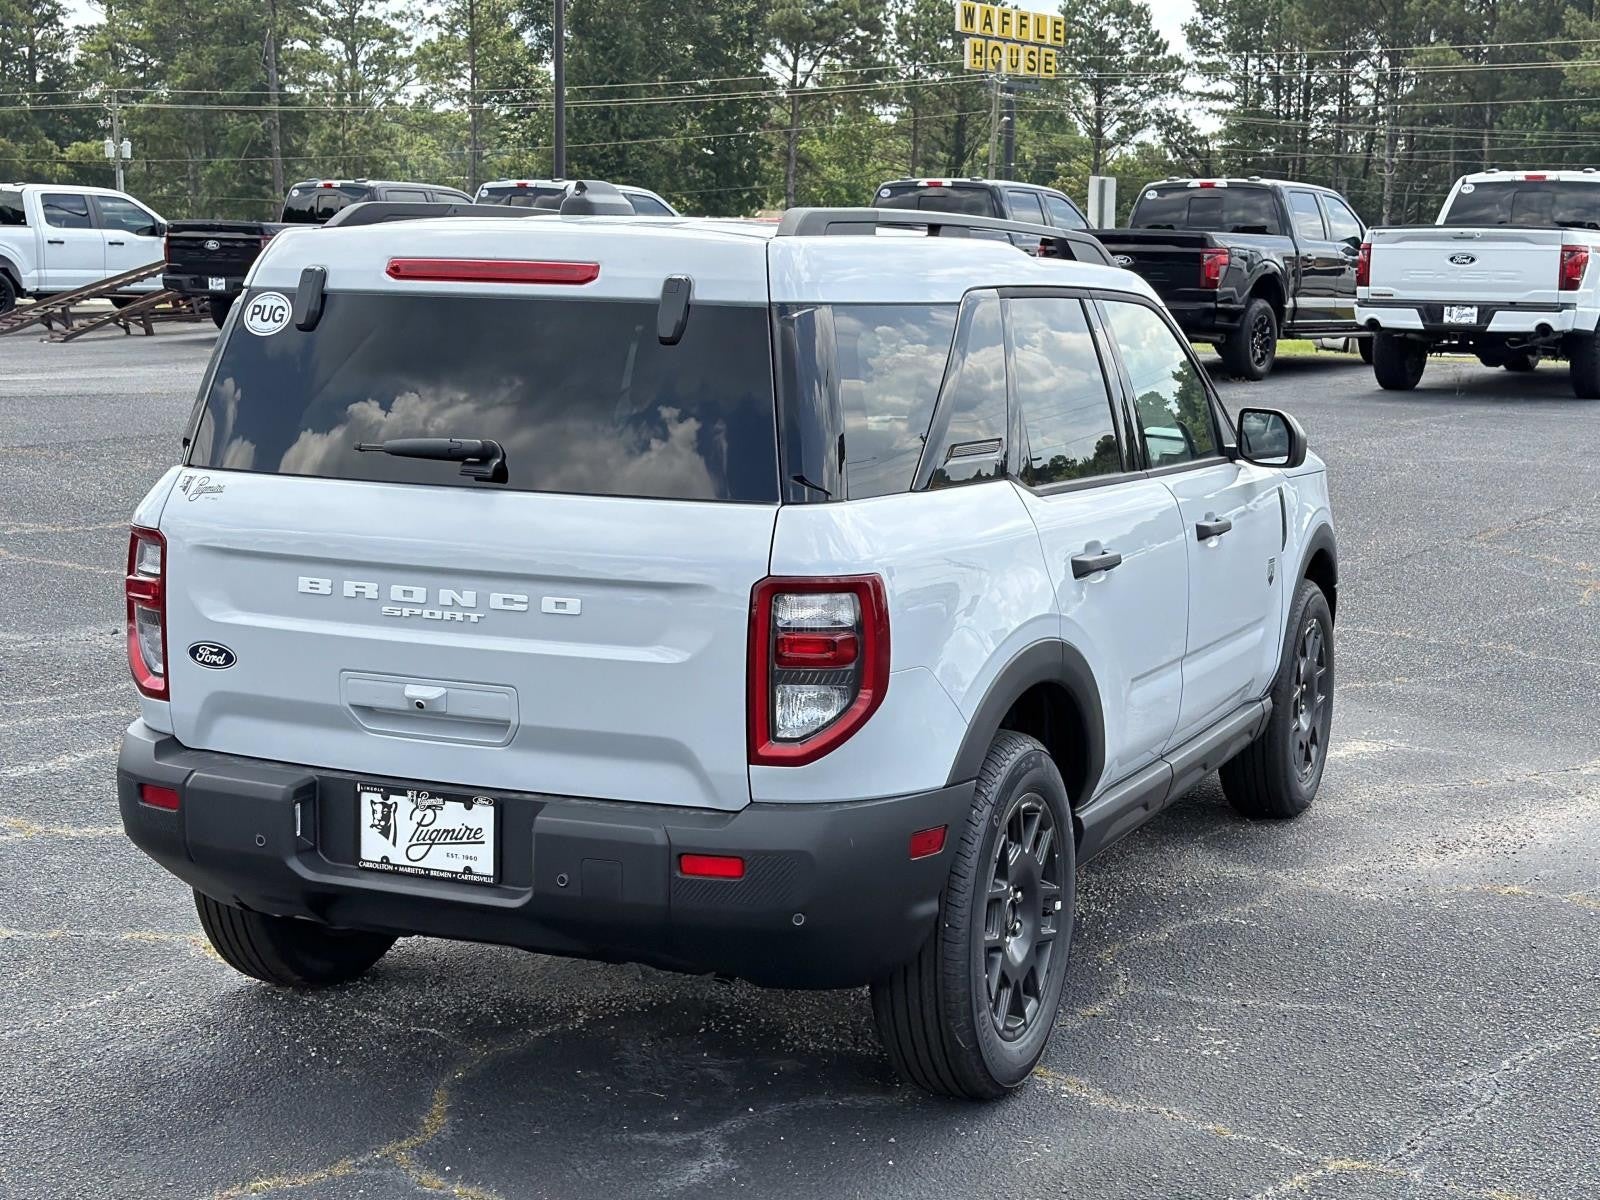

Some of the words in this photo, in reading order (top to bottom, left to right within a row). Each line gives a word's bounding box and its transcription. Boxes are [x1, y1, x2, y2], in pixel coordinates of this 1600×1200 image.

[963, 5, 1063, 42] WAFFLE
[973, 43, 1053, 74] HOUSE
[1452, 255, 1472, 265] Ford
[249, 304, 286, 324] PUG
[297, 576, 583, 616] BRONCO
[381, 606, 486, 623] SPORT
[196, 645, 227, 665] Ford
[405, 805, 486, 862] Pugmire
[446, 852, 460, 861] EST.
[461, 854, 478, 862] 1960
[358, 860, 394, 872] CARROLLTON
[398, 865, 425, 876] MARIETTA
[430, 869, 452, 879] BREMEN
[457, 872, 494, 884] CARTERSVILLE
